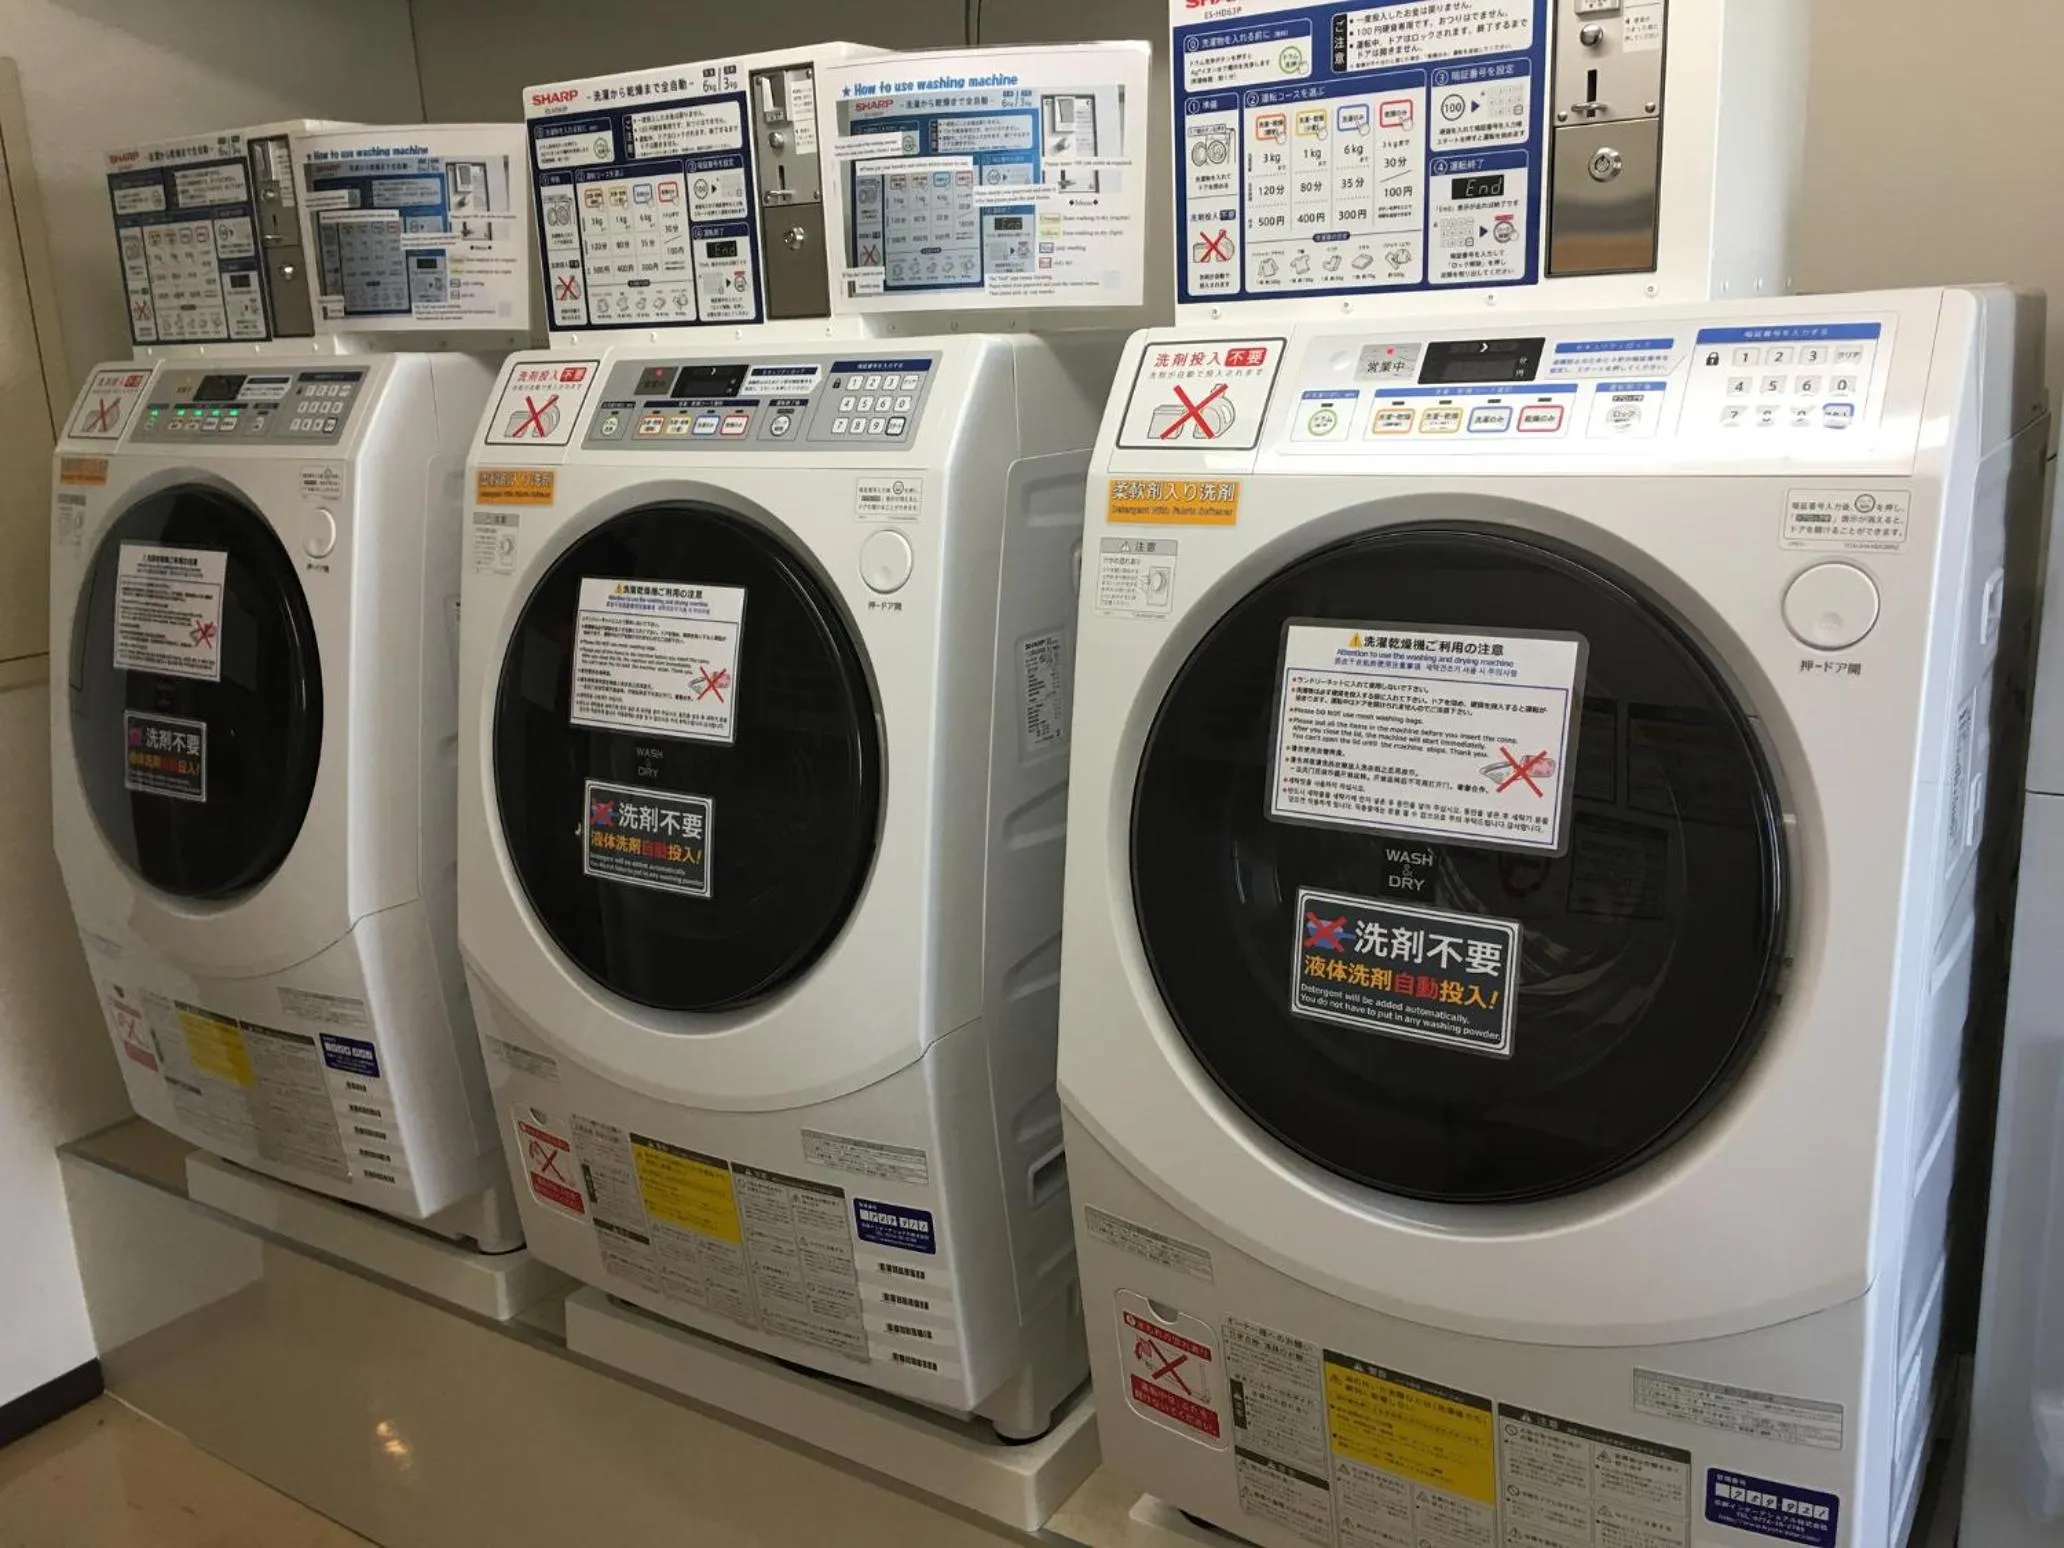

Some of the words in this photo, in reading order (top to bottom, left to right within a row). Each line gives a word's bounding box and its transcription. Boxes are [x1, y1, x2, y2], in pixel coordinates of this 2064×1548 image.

[854, 83, 876, 96] How
[879, 82, 891, 94] to
[894, 82, 914, 93] use
[917, 76, 965, 91] washing
[968, 74, 1018, 87] machine
[532, 89, 578, 106] SHARP
[855, 99, 894, 112] SHARP
[1385, 157, 1407, 168] 30分
[1301, 181, 1322, 192] 80分
[1342, 177, 1364, 188] 35分
[1466, 176, 1502, 196] End
[1260, 185, 1284, 196] 120分
[1385, 186, 1412, 197] 100円
[1259, 215, 1285, 227] 500円
[1297, 211, 1325, 223] 400円
[1338, 208, 1367, 221] 300円
[1155, 352, 1220, 367] 洗剤投入
[1228, 349, 1264, 365] 不要
[1742, 352, 1749, 363] 1
[1774, 351, 1784, 363] 2
[1809, 350, 1818, 362] 3
[1368, 360, 1405, 372] 営業中
[1735, 380, 1744, 392] 4
[1768, 380, 1777, 391] 5
[1802, 379, 1811, 391] 6
[1837, 379, 1847, 390] 0
[1113, 480, 1235, 502] 柔軟剤入り洗剤
[1364, 636, 1504, 656] 洗濯乾燥機ご利用の注意
[636, 747, 663, 759] WASH
[638, 766, 659, 777] DRY
[619, 801, 703, 839] 洗剤不要
[1386, 848, 1433, 867] WASH
[1389, 876, 1425, 892] DRY
[1354, 919, 1503, 978] 洗剤不要
[1301, 983, 1342, 1000] Detergent
[1345, 990, 1360, 1003] will
[1363, 994, 1374, 1005] be
[1375, 997, 1403, 1012] added
[1405, 1004, 1470, 1025] automatically.
[1300, 993, 1316, 1005] You
[1317, 996, 1327, 1007] do
[1329, 998, 1343, 1009] not
[1345, 1001, 1366, 1015] have
[1367, 1006, 1376, 1016] to
[1377, 1008, 1392, 1022] put
[1395, 1012, 1403, 1021] in
[1404, 1015, 1421, 1029] any
[1423, 1017, 1461, 1034] washing
[1463, 1026, 1502, 1042] powder.
